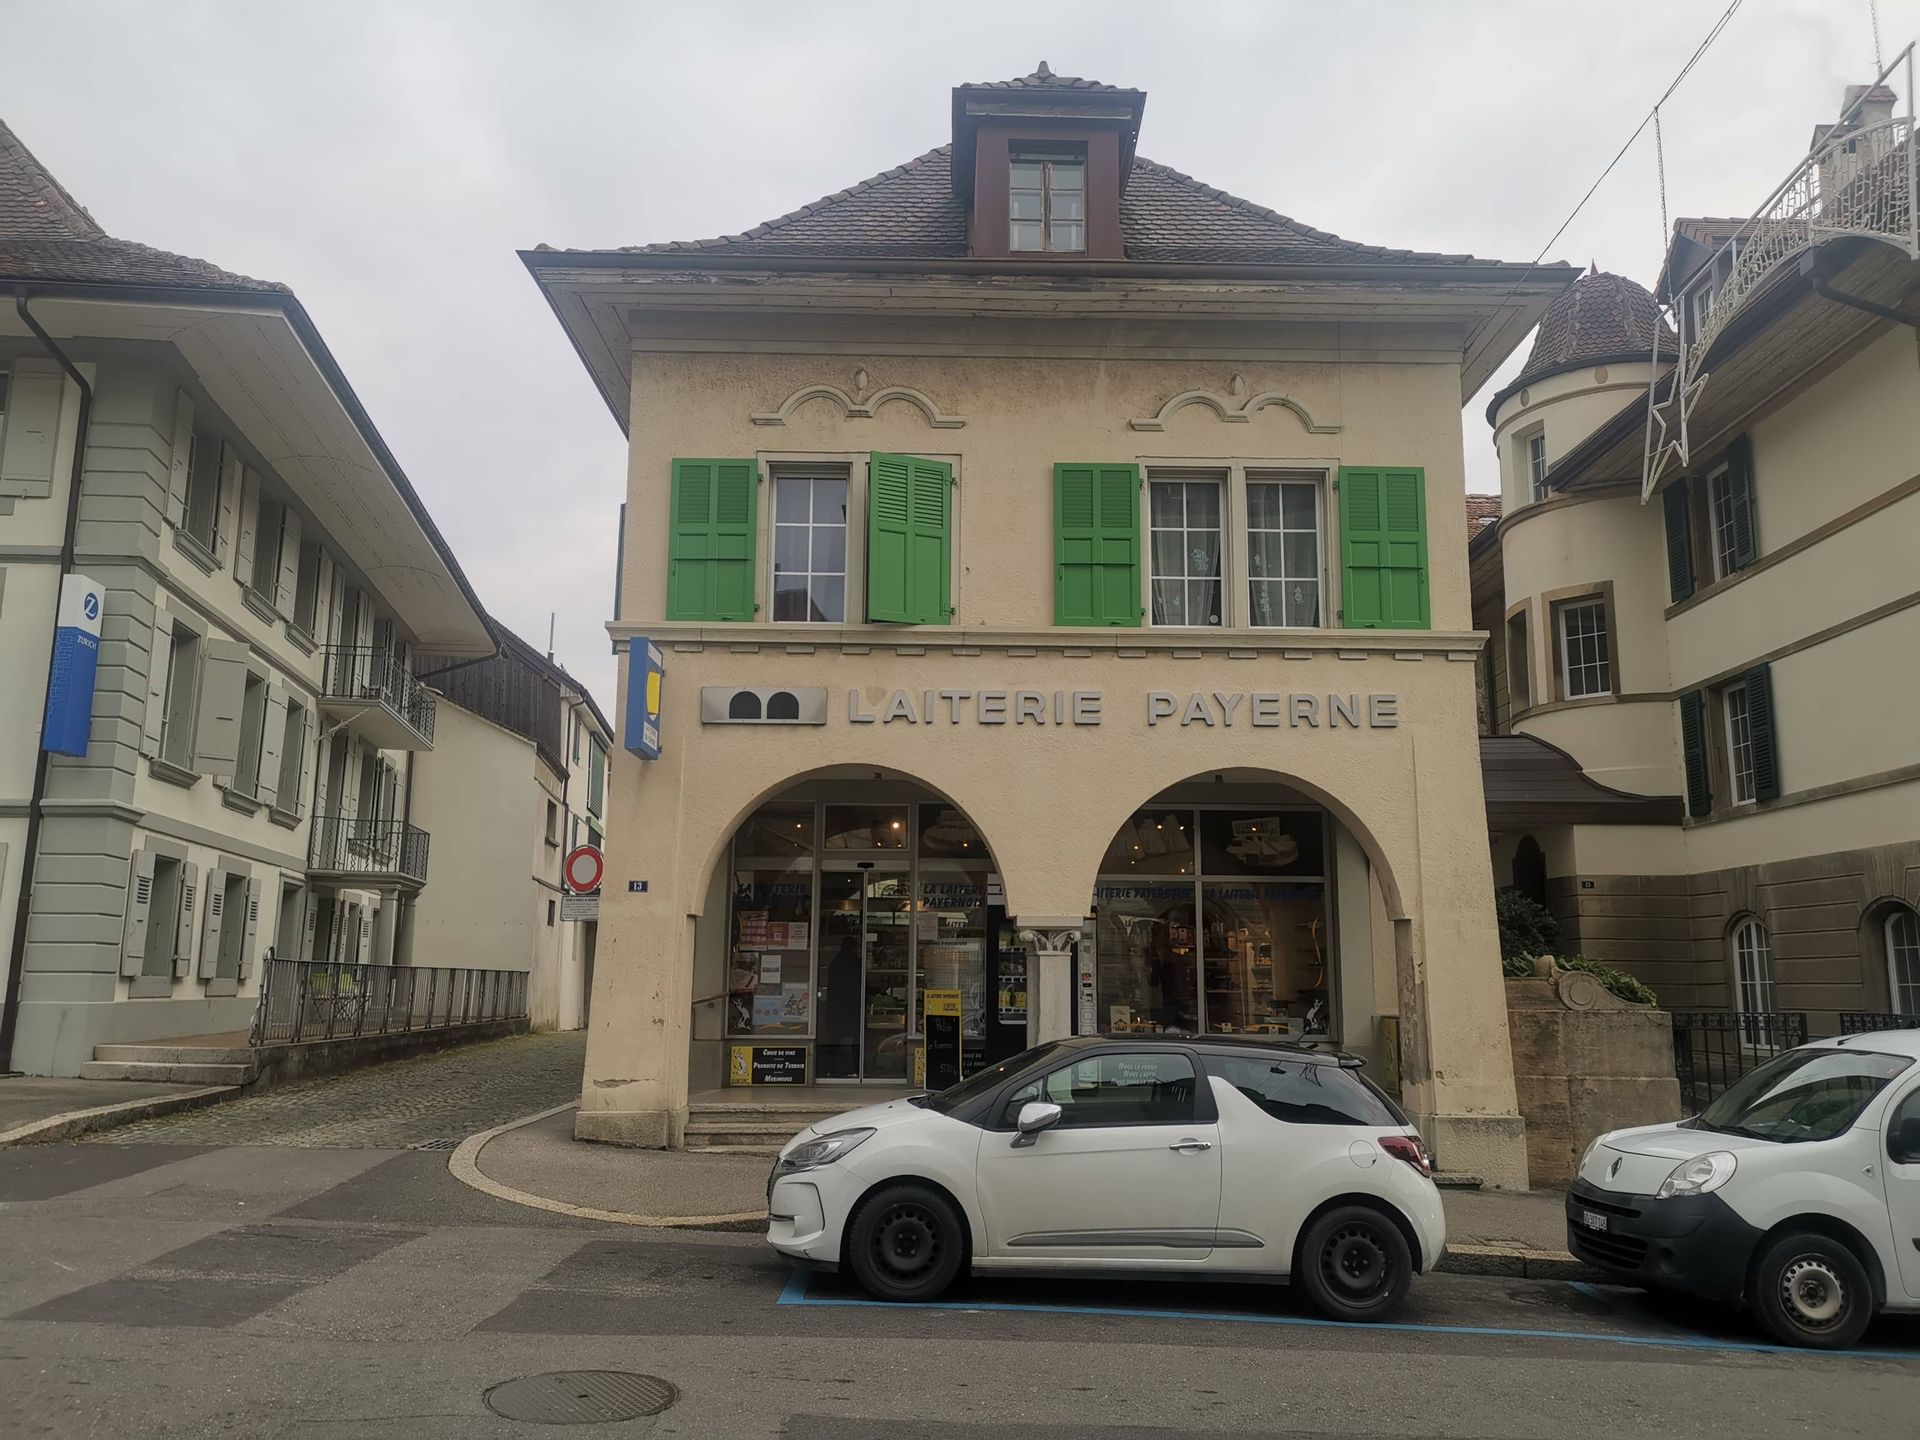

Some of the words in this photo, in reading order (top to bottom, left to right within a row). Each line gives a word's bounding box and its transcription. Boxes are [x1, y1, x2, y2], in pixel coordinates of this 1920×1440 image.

[77, 634, 97, 650] ZURICH
[849, 688, 1101, 726] LAITERIE
[1147, 691, 1399, 728] PAYERNE
[633, 881, 643, 891] 13
[923, 884, 937, 896] LA
[1094, 887, 1132, 898] AITERIE
